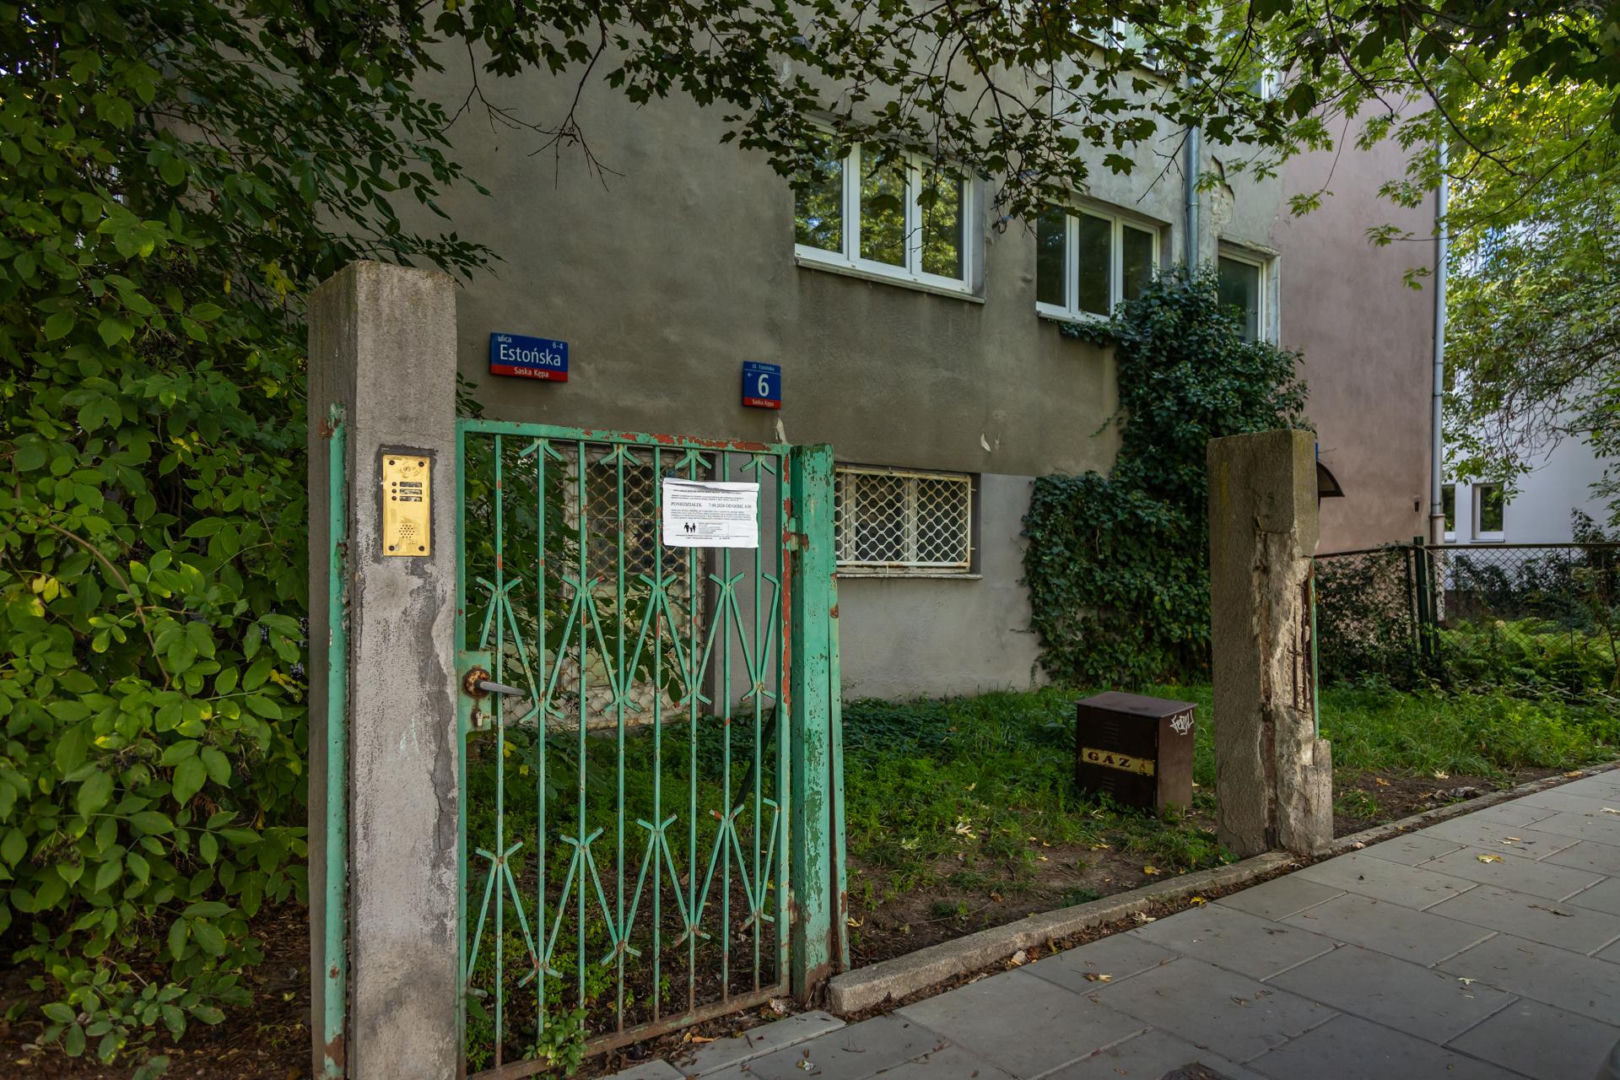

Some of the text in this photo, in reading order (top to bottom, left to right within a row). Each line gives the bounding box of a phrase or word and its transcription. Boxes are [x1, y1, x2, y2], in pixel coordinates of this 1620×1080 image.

[497, 335, 512, 343] ulica
[500, 344, 561, 366] Estońska
[514, 366, 549, 379] Saska Kępa
[758, 373, 770, 397] 6
[1087, 751, 1131, 767] GAZ
